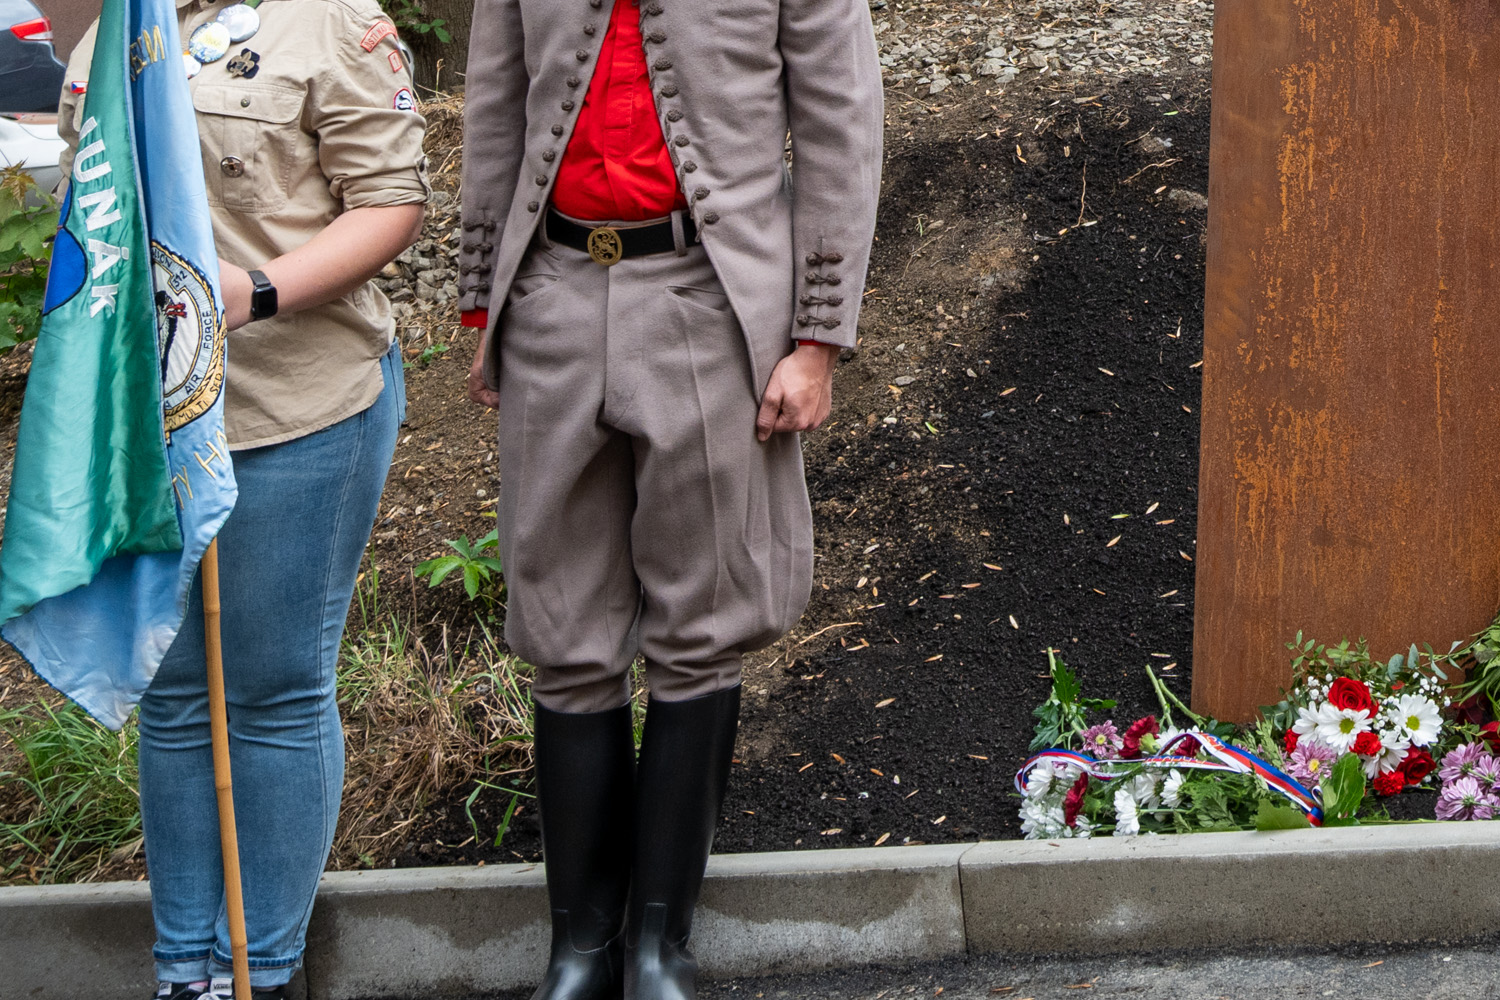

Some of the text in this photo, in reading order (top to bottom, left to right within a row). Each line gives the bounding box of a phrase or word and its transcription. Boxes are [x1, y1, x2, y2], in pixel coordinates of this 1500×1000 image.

[172, 270, 188, 288] 312
[184, 310, 213, 395] AIR FORCE
